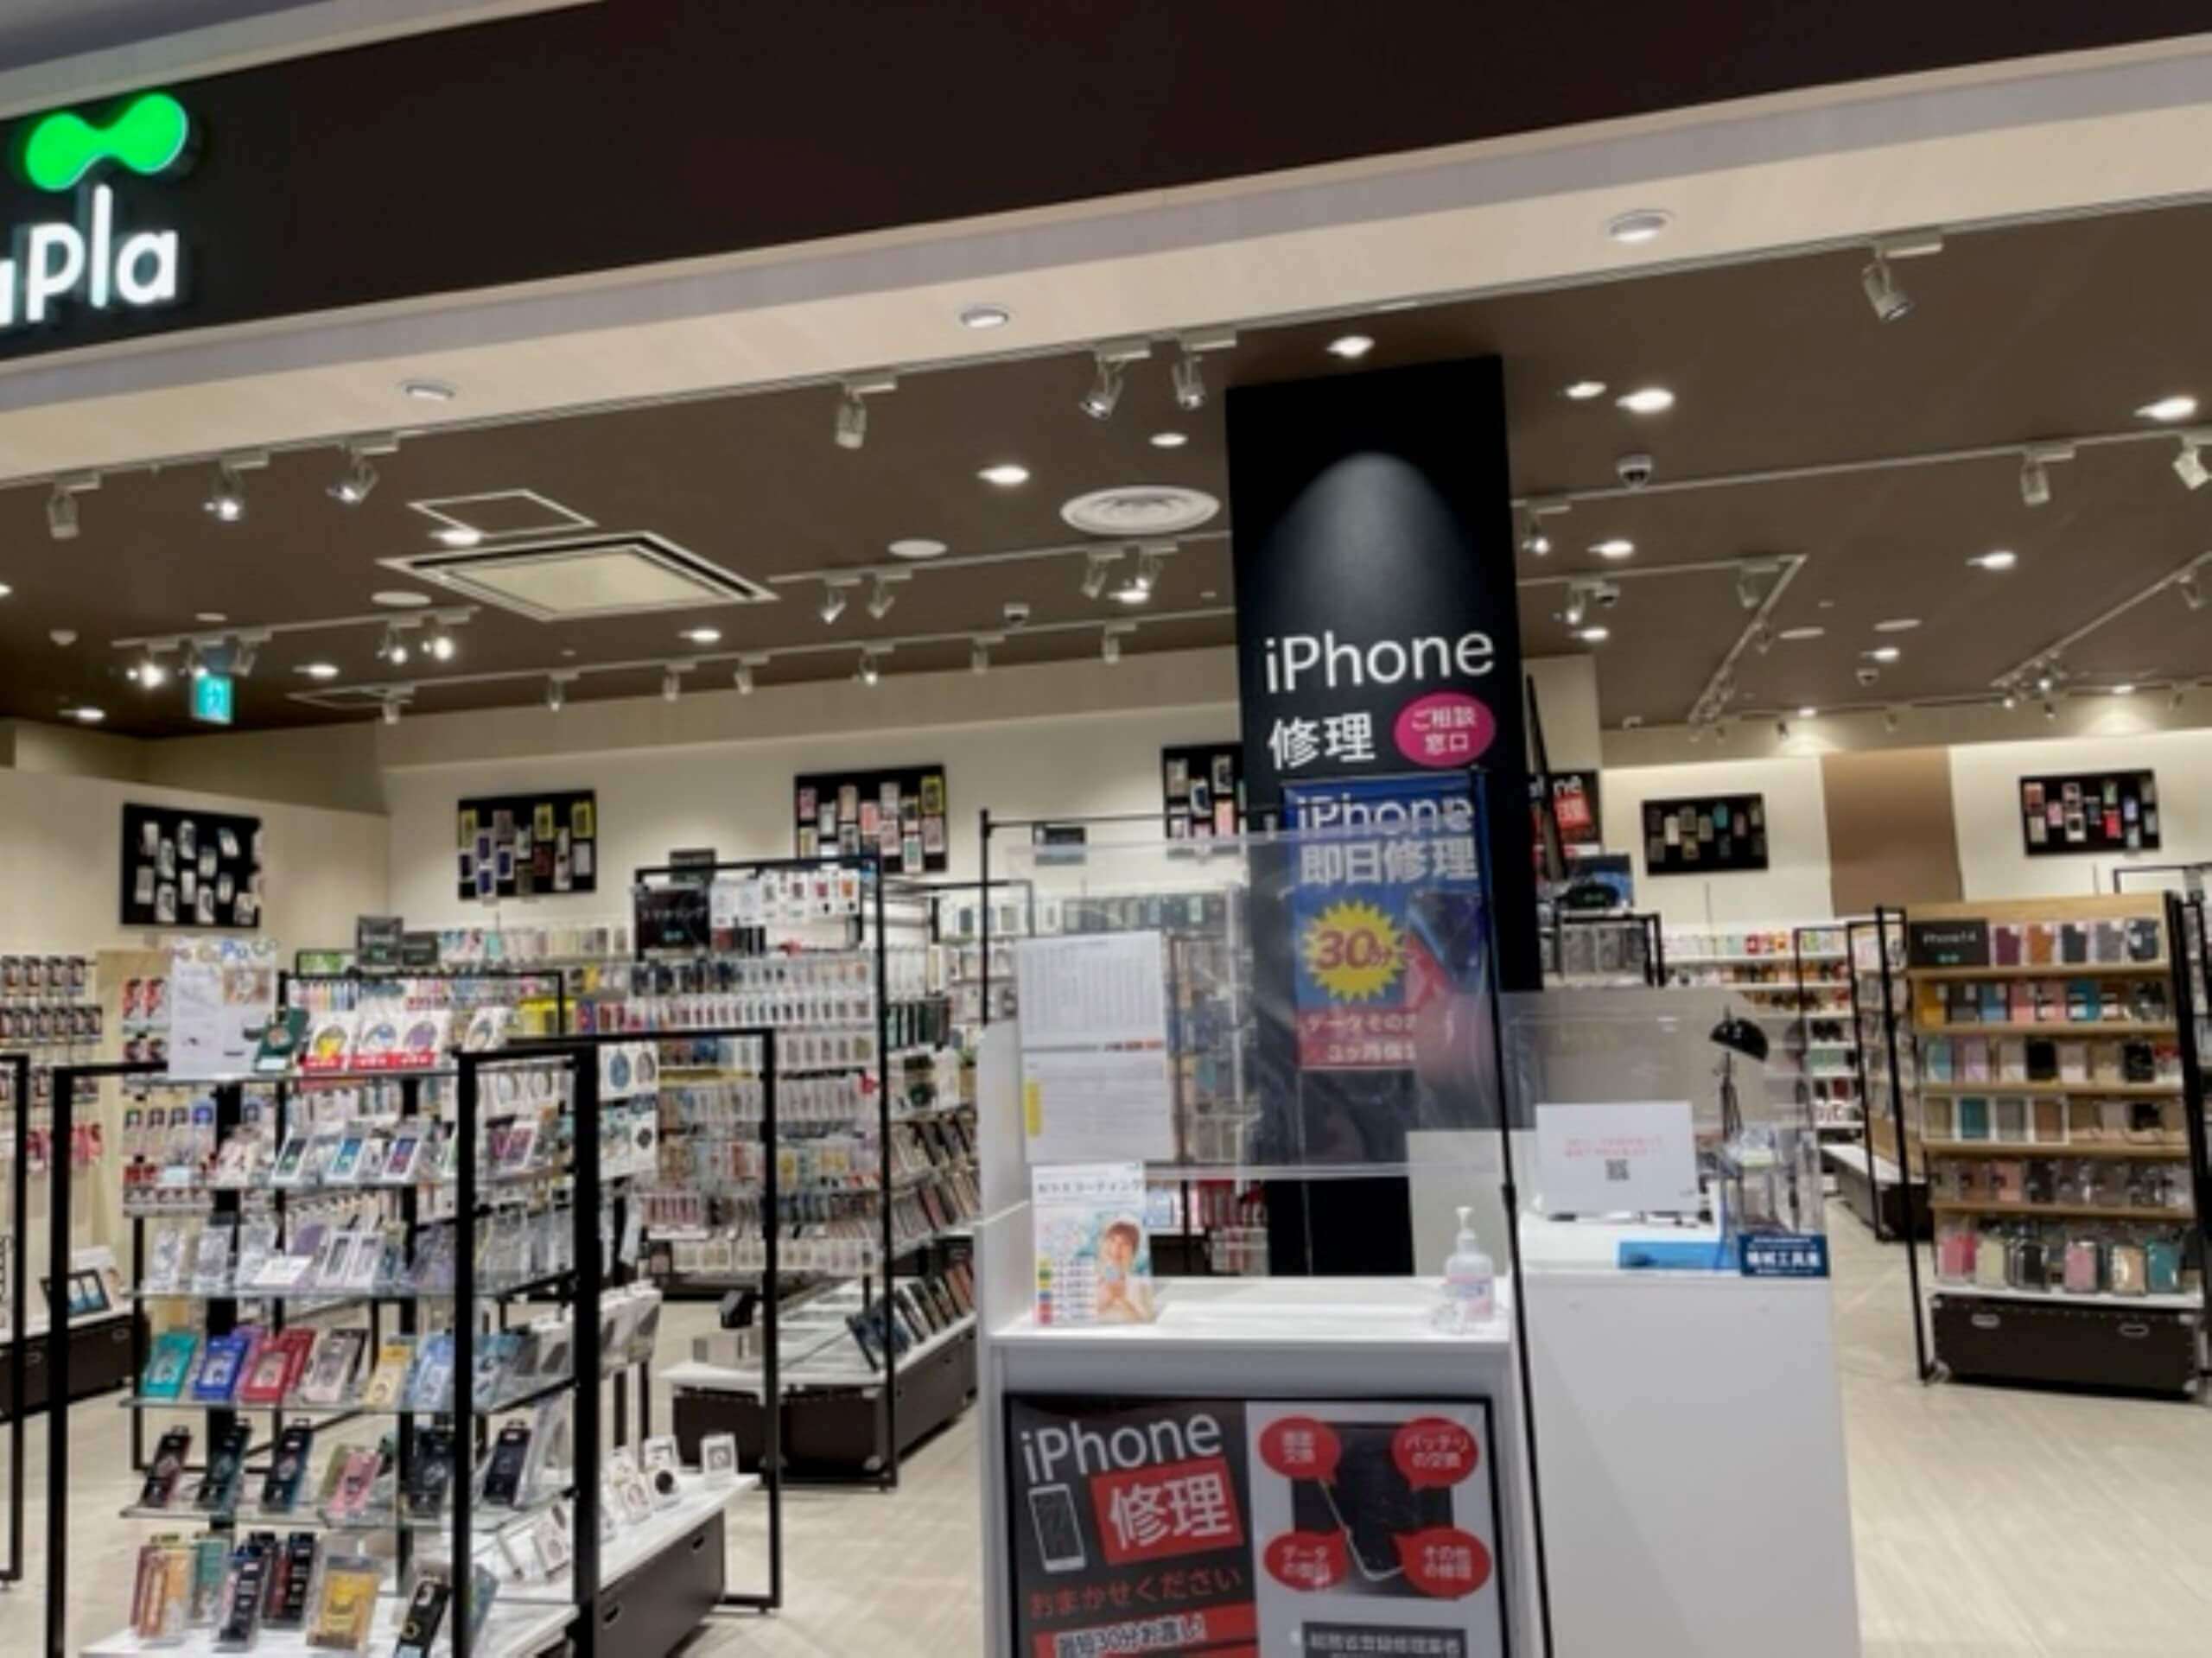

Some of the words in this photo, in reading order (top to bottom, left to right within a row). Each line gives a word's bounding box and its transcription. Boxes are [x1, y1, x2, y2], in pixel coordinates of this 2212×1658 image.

[1264, 630, 1495, 694] iPhone
[1268, 711, 1376, 771] 修理
[1411, 705, 1477, 732] ご相談
[1424, 733, 1470, 755] 窓口
[1296, 792, 1474, 839] iPhone
[1300, 835, 1479, 886] 即日修理
[1020, 1413, 1223, 1484] iPhone
[1109, 1471, 1233, 1550] 修理
[1029, 1567, 1243, 1618] おまかせください
